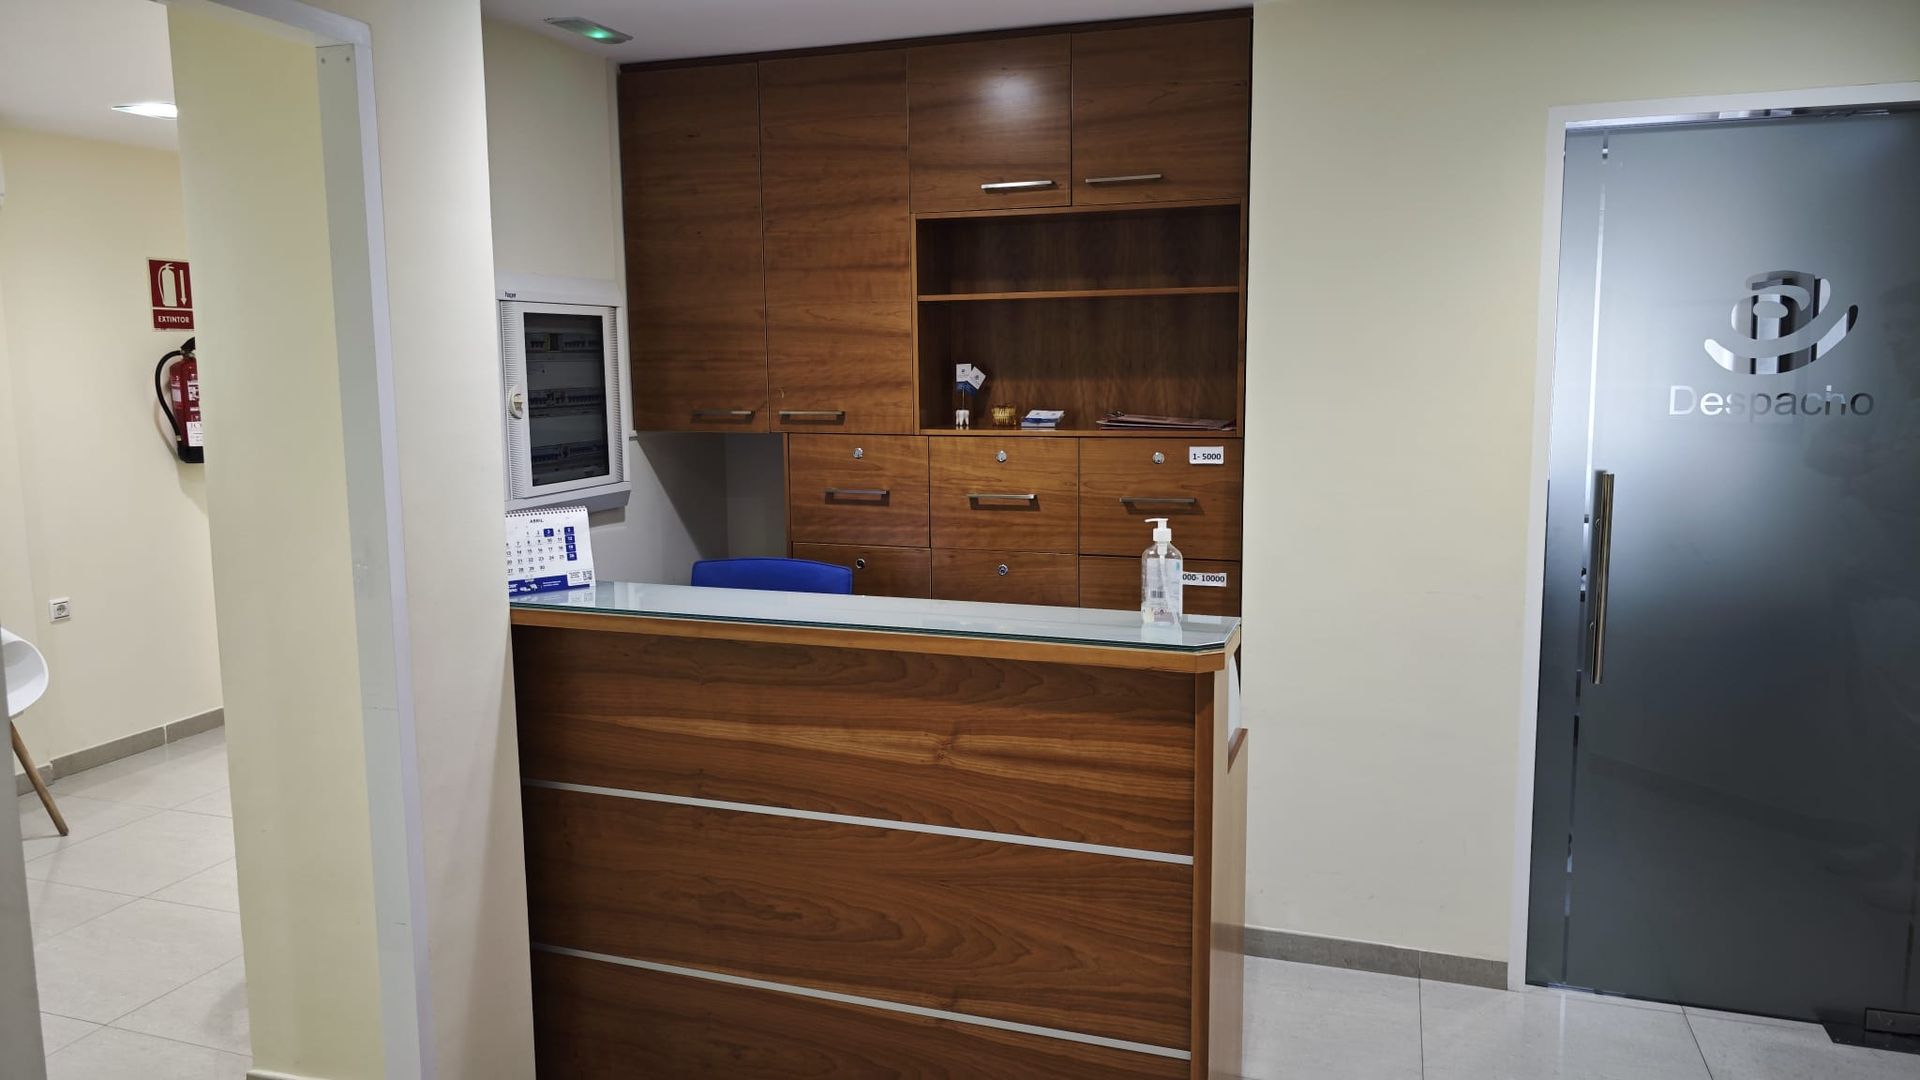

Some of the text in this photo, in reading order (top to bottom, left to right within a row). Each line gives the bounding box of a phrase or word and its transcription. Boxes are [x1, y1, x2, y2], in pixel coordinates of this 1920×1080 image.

[157, 315, 190, 323] EXTINTOR
[1668, 384, 1875, 423] Despacho
[1202, 574, 1225, 583] 10000
